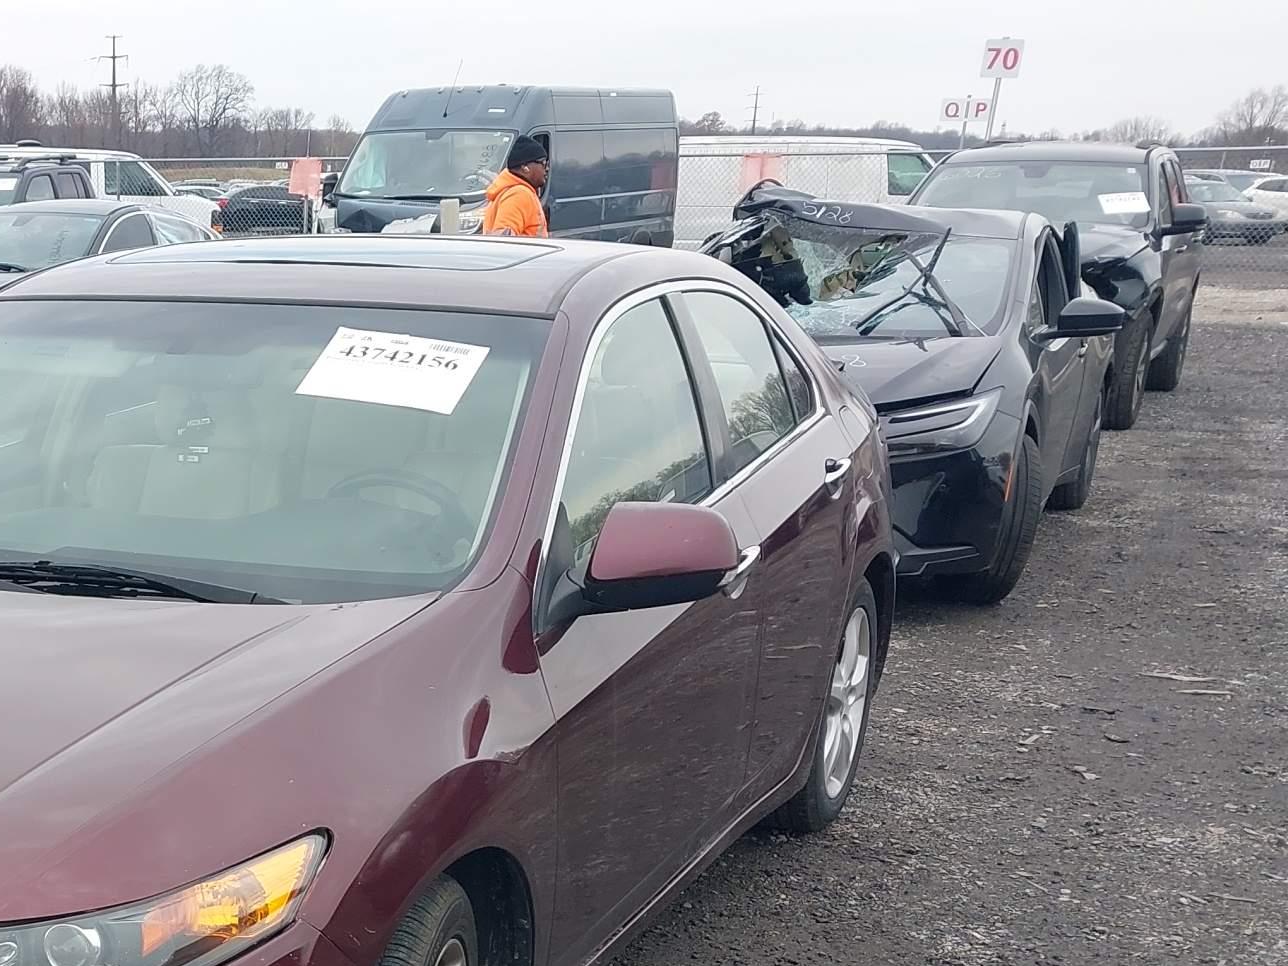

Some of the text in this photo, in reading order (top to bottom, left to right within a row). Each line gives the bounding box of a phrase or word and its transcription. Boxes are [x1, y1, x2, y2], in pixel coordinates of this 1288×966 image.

[987, 47, 1019, 70] 70
[944, 102, 988, 118] Q P
[338, 344, 460, 371] 43742156
